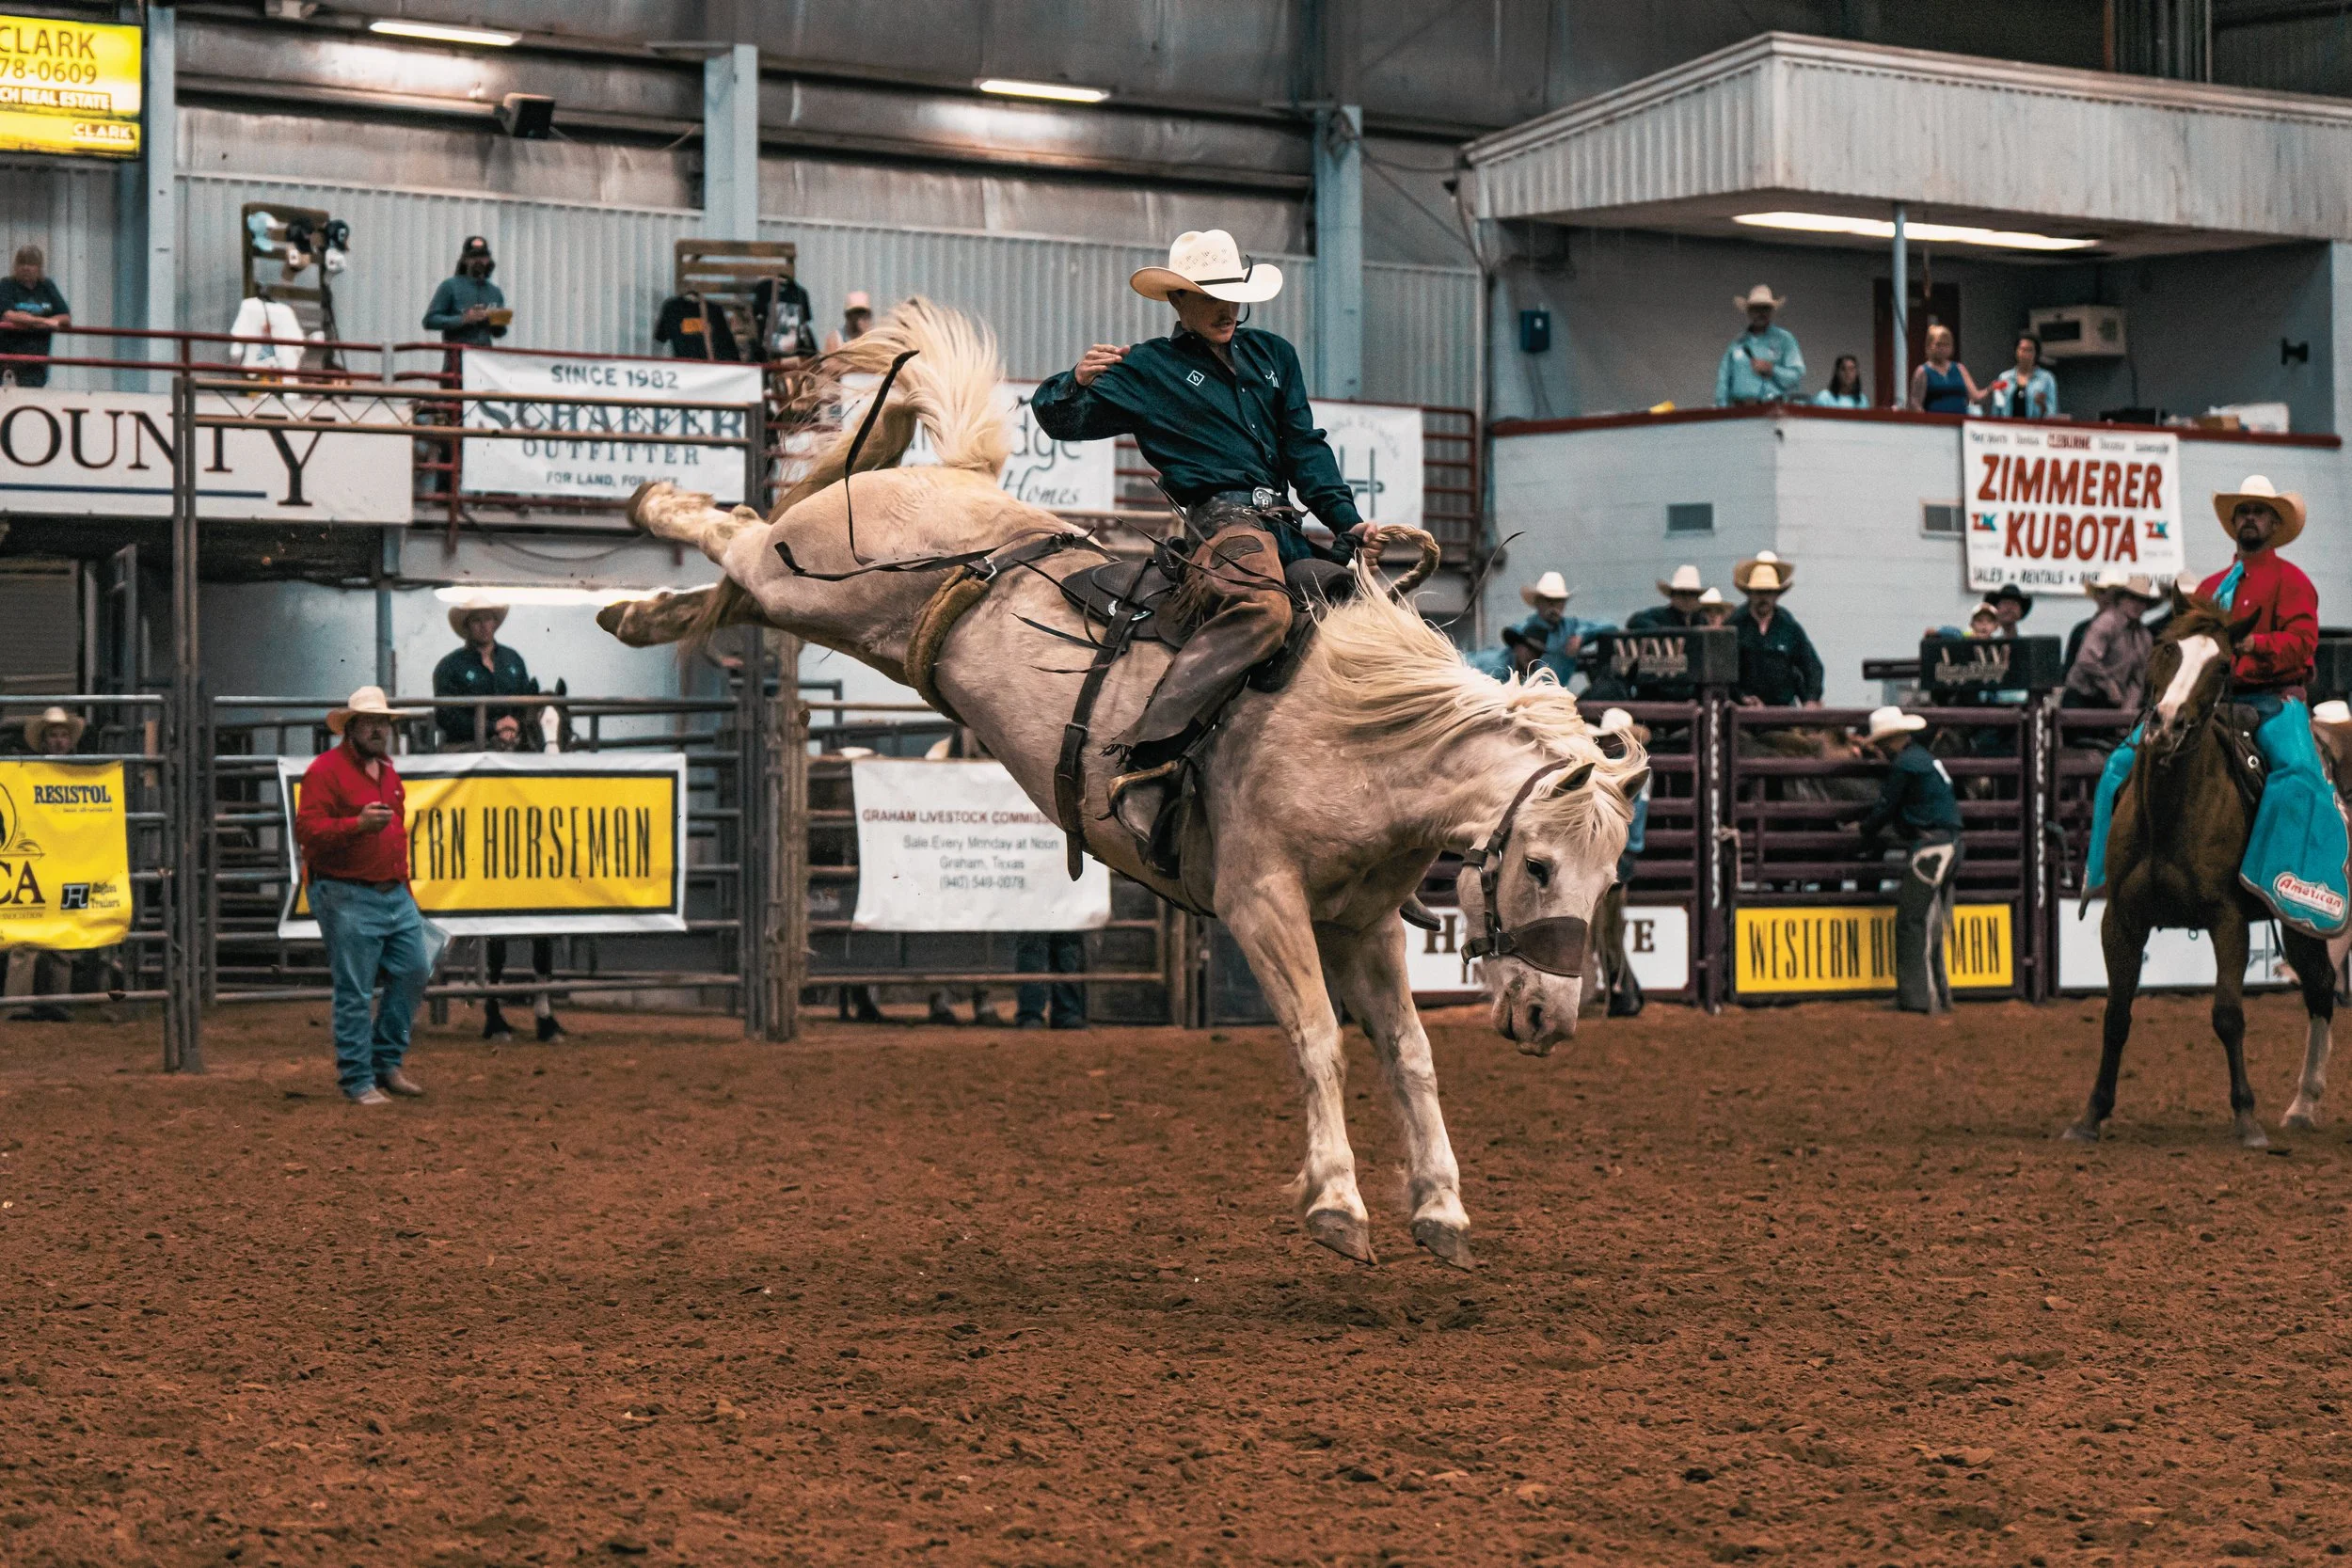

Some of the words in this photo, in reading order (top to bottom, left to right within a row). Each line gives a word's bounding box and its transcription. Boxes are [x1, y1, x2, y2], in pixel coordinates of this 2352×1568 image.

[0, 25, 95, 59] CLARK
[21, 88, 58, 107] REAL
[59, 91, 110, 110] ESTATE
[73, 122, 134, 139] CLARK
[550, 364, 617, 387] SINCE
[626, 370, 679, 389] 1982
[523, 439, 700, 466] OUTFITTER
[547, 472, 572, 484] FOR
[1978, 453, 2163, 509] ZIMMERER
[2005, 511, 2138, 562] KUBOTA
[34, 784, 112, 804] RESISTOL
[863, 809, 916, 823] GRAHAM
[919, 810, 988, 824] LIVESTOCK
[483, 805, 650, 879] HORSEMAN
[903, 835, 928, 848] Sale
[931, 835, 963, 851] Every
[967, 836, 1012, 850] Monday
[993, 857, 1025, 869] Texas
[2280, 878, 2342, 908] American
[1748, 916, 1860, 979] WESTERN
